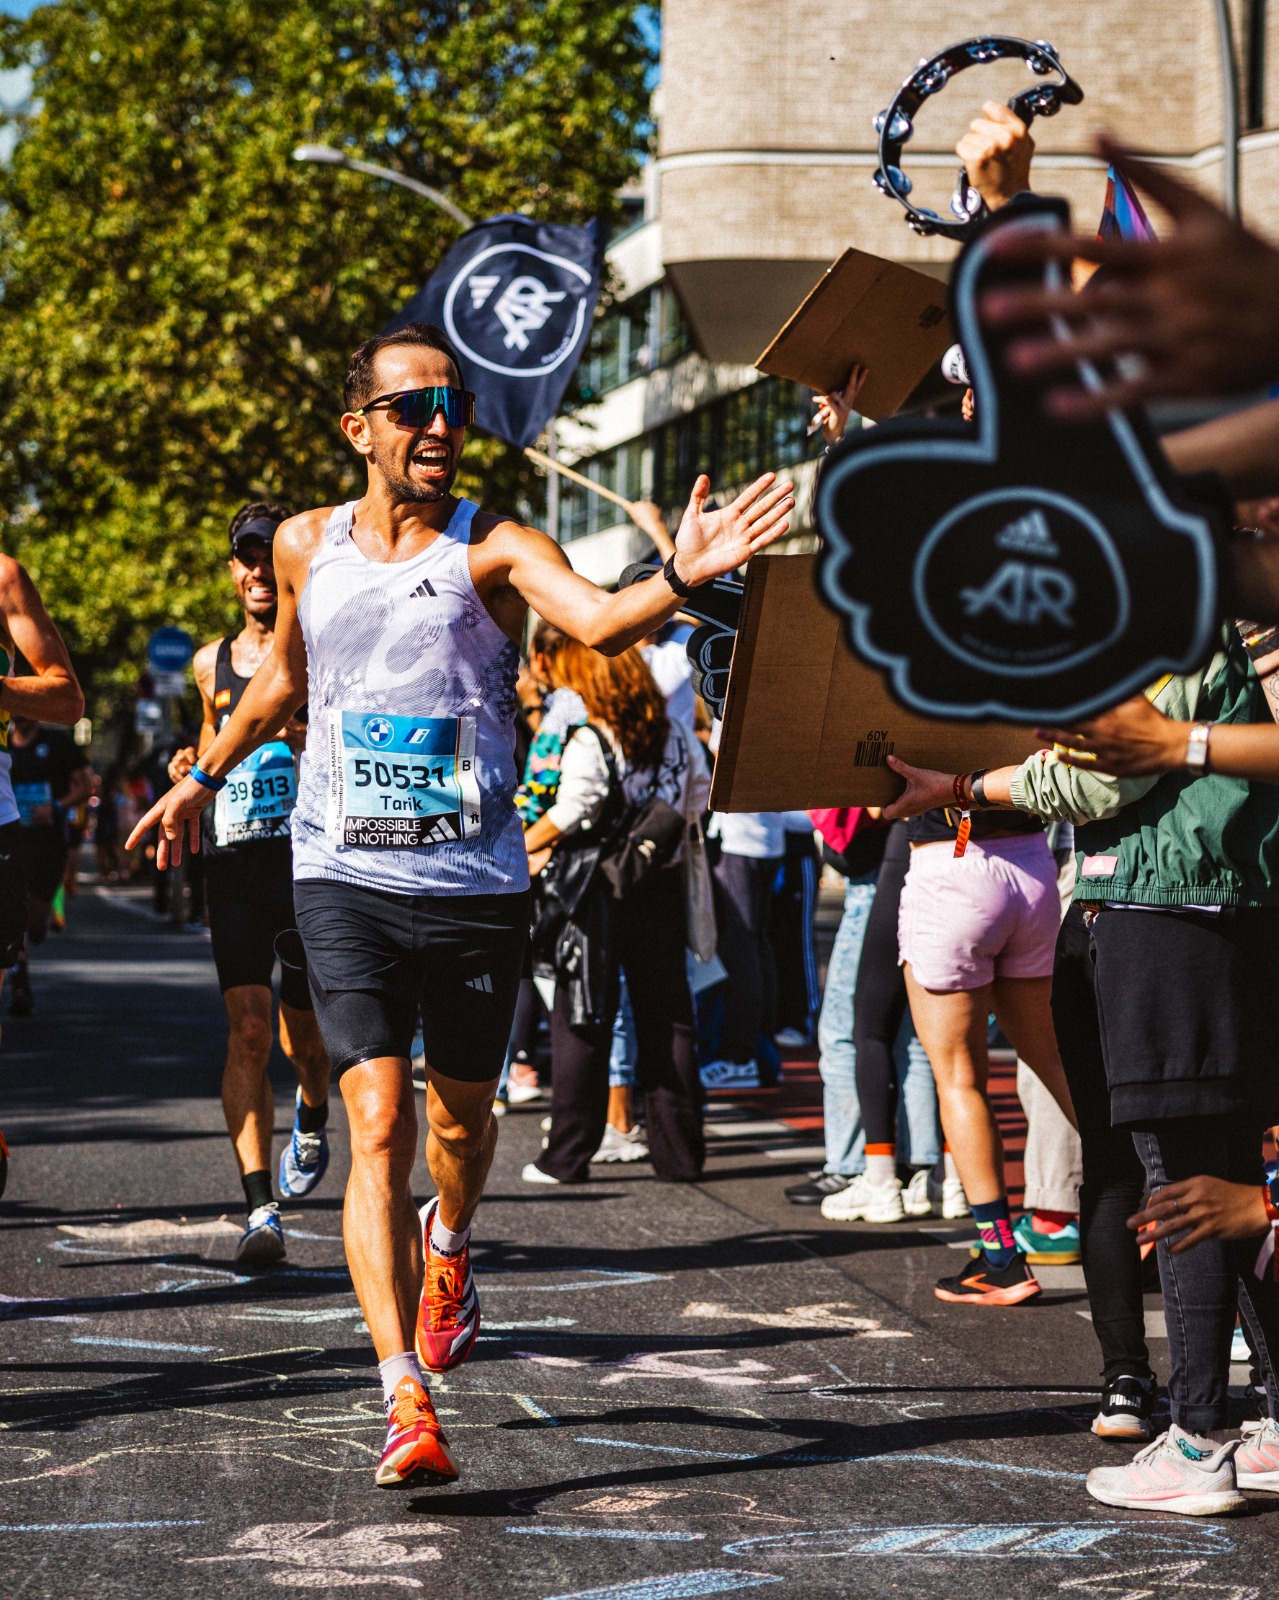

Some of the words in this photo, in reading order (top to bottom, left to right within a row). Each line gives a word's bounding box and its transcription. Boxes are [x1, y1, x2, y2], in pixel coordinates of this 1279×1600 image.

[462, 760, 471, 771] B
[354, 759, 447, 790] 50531
[228, 775, 290, 803] 39813
[336, 784, 344, 819] September
[380, 795, 424, 811] Tarik
[242, 803, 276, 817] Carlos
[346, 818, 422, 832] IMPOSSIBLE
[345, 831, 357, 844] IS
[359, 832, 419, 846] NOTHING
